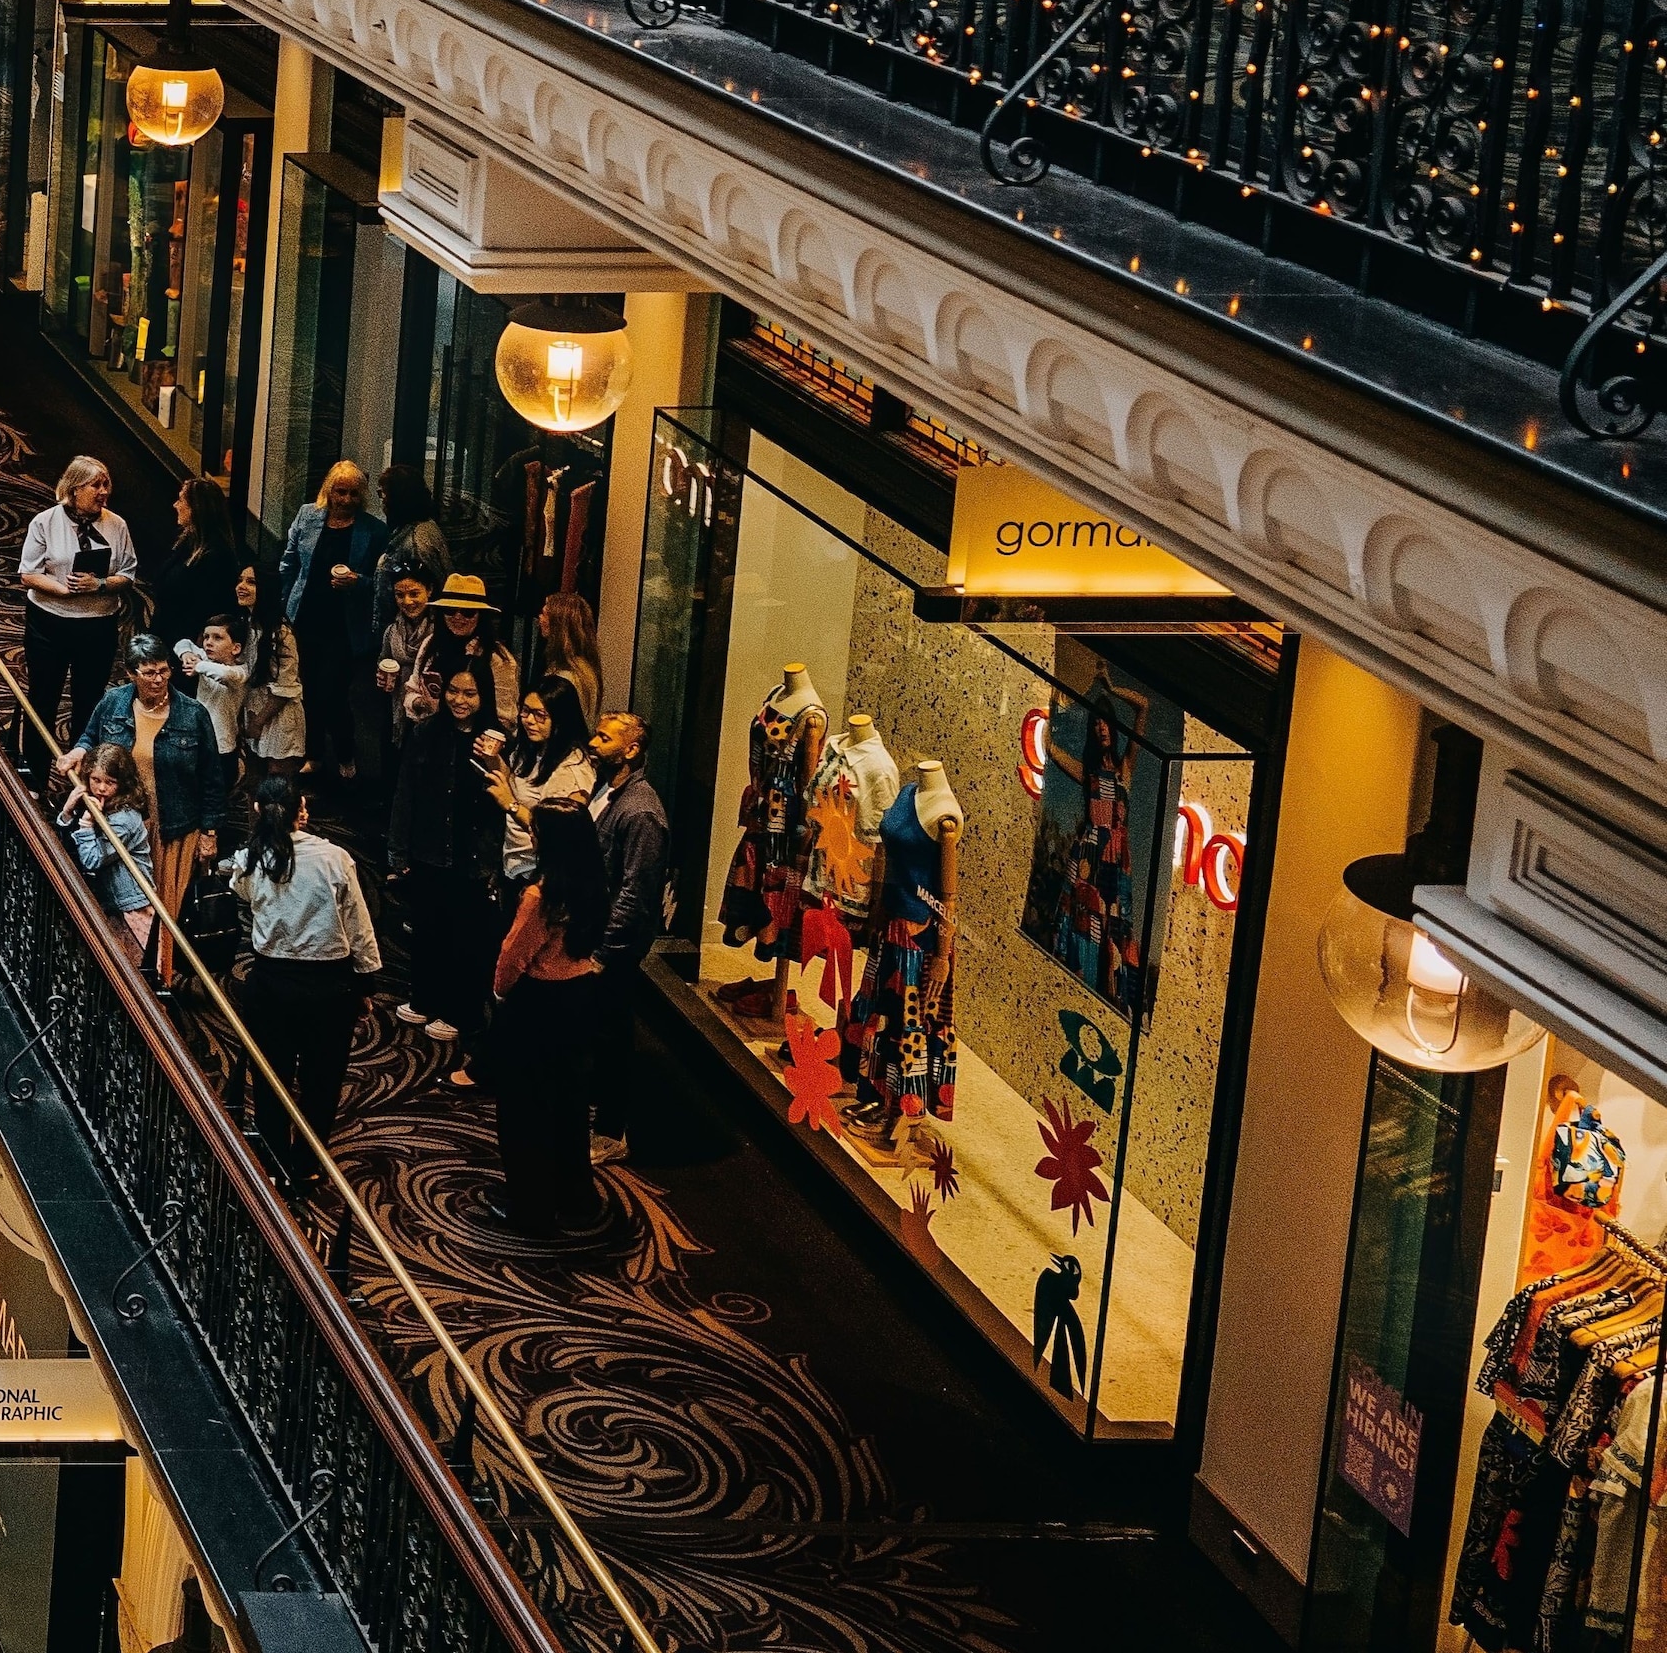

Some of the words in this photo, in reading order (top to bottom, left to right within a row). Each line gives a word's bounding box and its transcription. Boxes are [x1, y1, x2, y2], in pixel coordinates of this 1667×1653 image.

[995, 520, 1152, 556] gorma
[1346, 1400, 1416, 1477] HIRING!
[1349, 1376, 1377, 1417] WE
[1380, 1408, 1418, 1454] ARE
